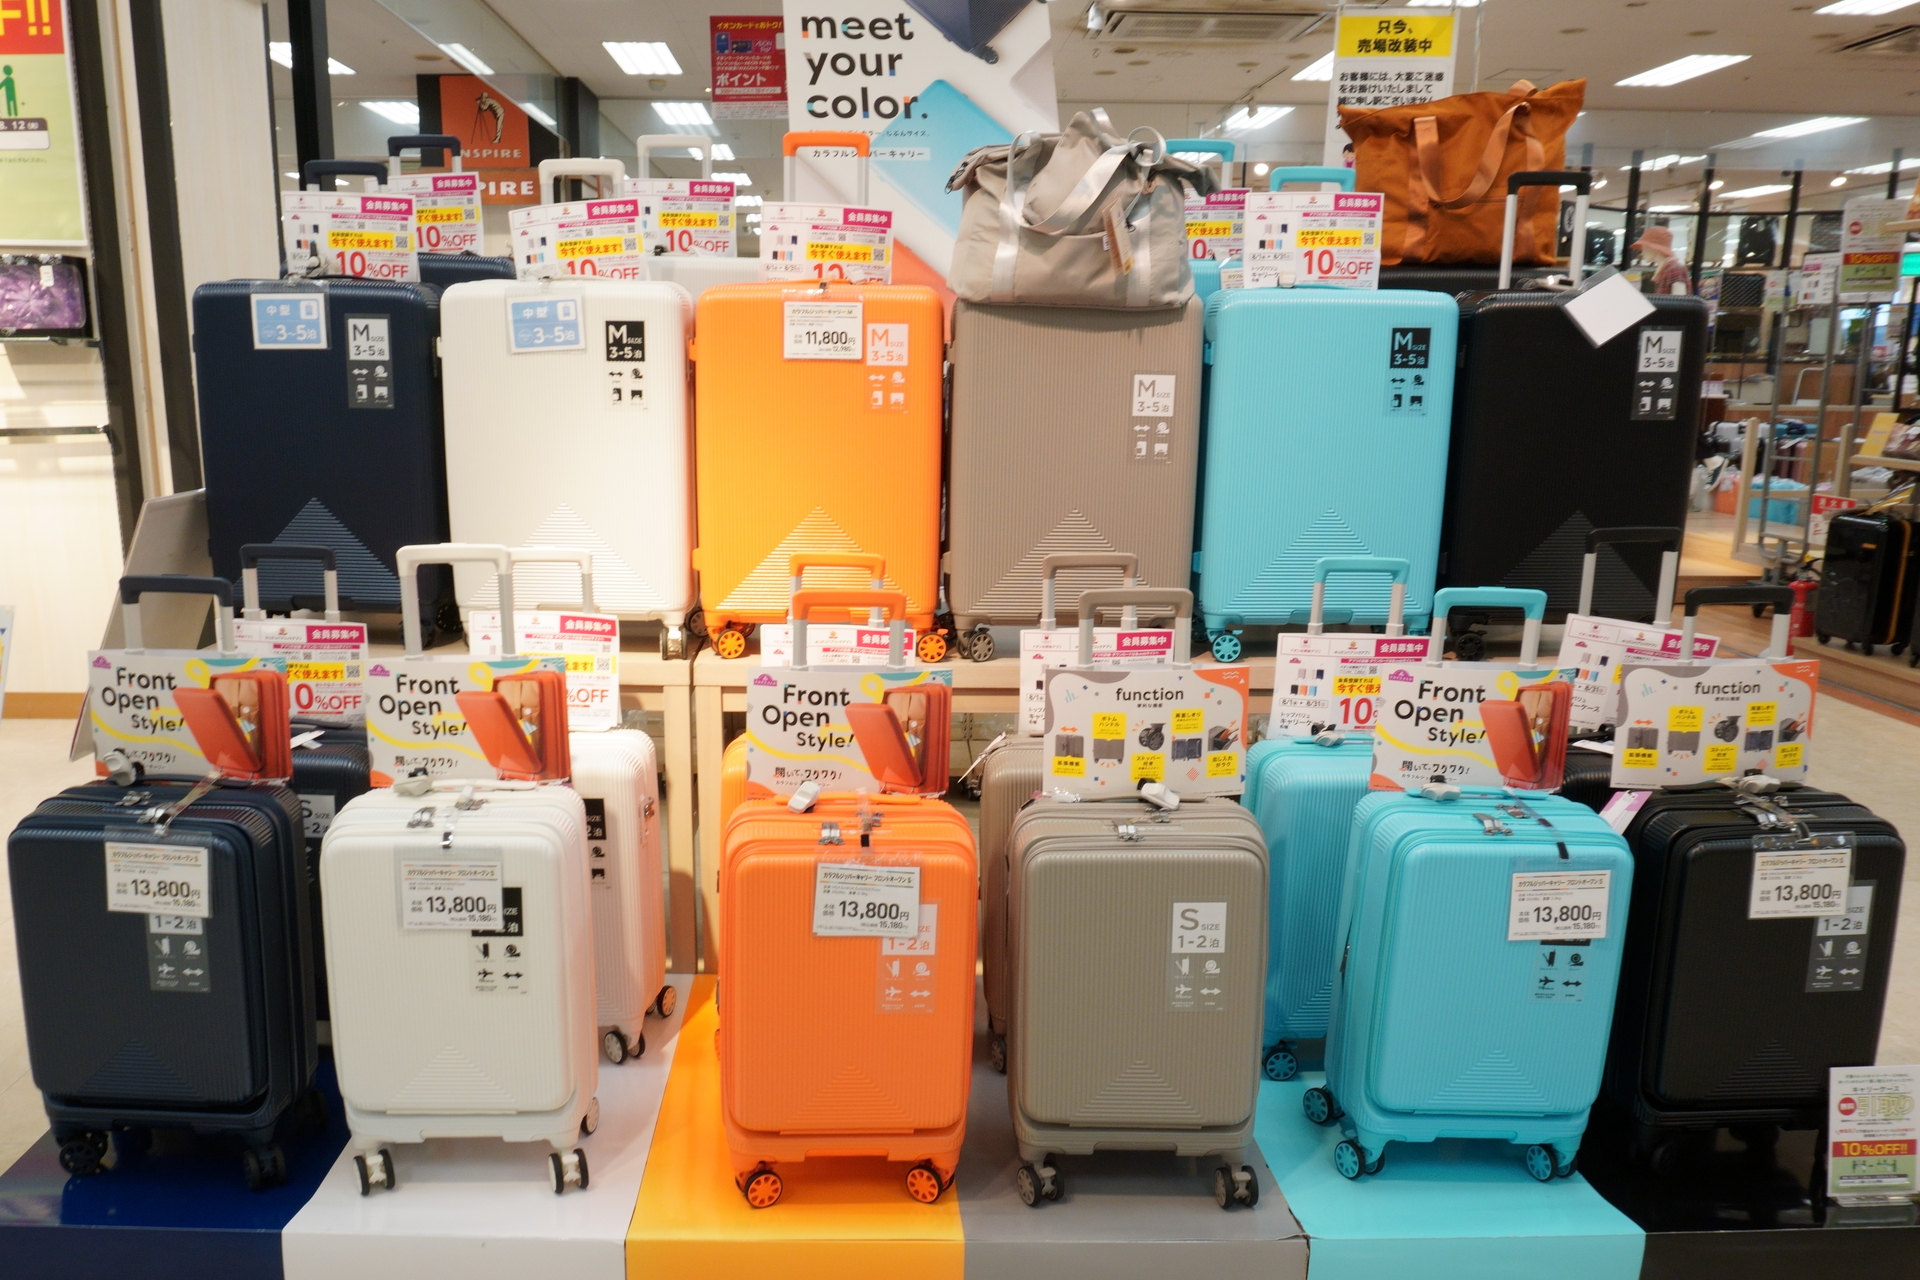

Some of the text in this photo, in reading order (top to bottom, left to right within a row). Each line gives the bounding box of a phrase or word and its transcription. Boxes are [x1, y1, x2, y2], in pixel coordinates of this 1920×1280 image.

[801, 13, 914, 40] meet
[1377, 19, 1413, 34] 只今、
[1357, 38, 1432, 53] 売場改装中
[803, 52, 903, 85] your
[716, 73, 767, 86] ポイント
[806, 86, 928, 119] color.
[460, 148, 521, 158] NSPIRE
[436, 179, 473, 189] 会員募集中
[693, 183, 731, 194] 会員募集中
[365, 200, 409, 212] 会員募集中
[592, 204, 634, 216] 会員募集中
[1338, 197, 1378, 208] 会員募集中
[336, 251, 409, 276] 10%OFF
[1303, 249, 1374, 275] 10%OFF
[266, 304, 291, 316] 中型
[522, 306, 548, 319] 中型
[353, 324, 370, 342] M
[608, 324, 628, 344] M
[805, 331, 856, 345] 11,800円
[872, 329, 889, 347] M
[1394, 332, 1413, 351] M
[1645, 336, 1663, 354] M
[1138, 380, 1155, 398] M
[312, 629, 359, 639] 会員募集中
[565, 619, 611, 632] 会員募集中
[1122, 636, 1167, 647] 会員募集中
[1380, 643, 1424, 653] 会員募集中
[116, 667, 177, 690] Front
[396, 674, 460, 695] Front
[1695, 681, 1761, 695] function
[101, 687, 160, 713] Open
[295, 683, 362, 710] 0%OFF
[783, 684, 850, 706] Front
[1116, 688, 1184, 701] function
[1418, 680, 1486, 703] Front
[379, 695, 442, 721] Open
[1394, 700, 1464, 727] Open
[131, 714, 184, 734] Style!
[762, 705, 830, 732] Open
[412, 721, 467, 740] Style!
[1427, 727, 1485, 746] Style!
[796, 732, 854, 751] Style!
[130, 879, 200, 898] 13,800円
[1774, 883, 1842, 902] 13,800円
[426, 896, 496, 915] 13,800円
[838, 901, 909, 920] 13,800円
[1533, 905, 1601, 923] 13,800円
[1180, 908, 1199, 931] S
[1858, 1095, 1915, 1117] 引取り
